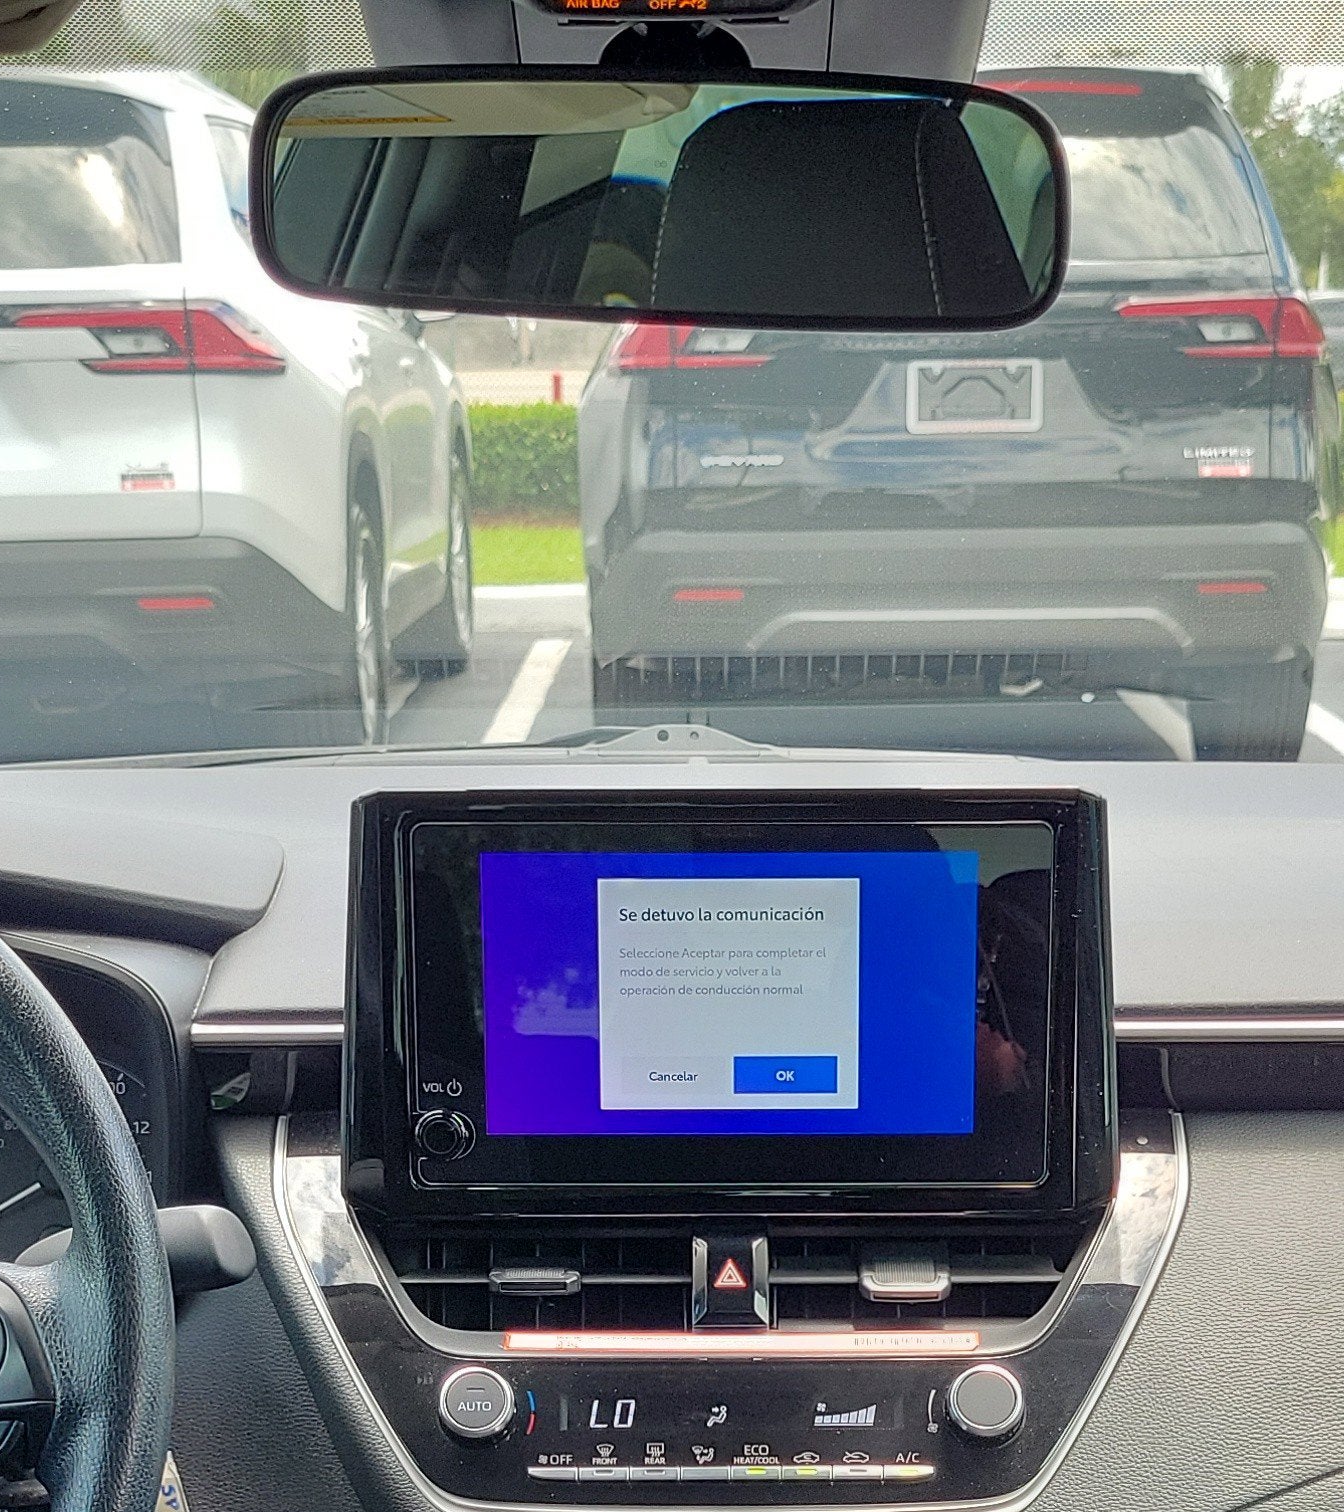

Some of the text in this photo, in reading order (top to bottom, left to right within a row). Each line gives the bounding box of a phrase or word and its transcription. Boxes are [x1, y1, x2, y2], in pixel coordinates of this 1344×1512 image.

[566, 0, 620, 9] AIR BAG
[619, 906, 825, 922] Se detuvo la comunicación
[619, 947, 827, 961] Seleccione Aceptar para completar el
[619, 966, 782, 979] modo de servicio y volver a la
[619, 984, 804, 998] operación de conducción normal
[648, 1071, 698, 1082] Cancelar
[775, 1070, 795, 1082] OK
[422, 1082, 445, 1093] VOL
[457, 1401, 492, 1412] AUTO
[743, 1444, 770, 1456] ECO
[549, 1455, 574, 1465] OFF
[591, 1457, 618, 1466] FRONT
[644, 1457, 666, 1465] REAR
[733, 1456, 780, 1465] HEAT/COOL
[895, 1452, 920, 1464] A/C
